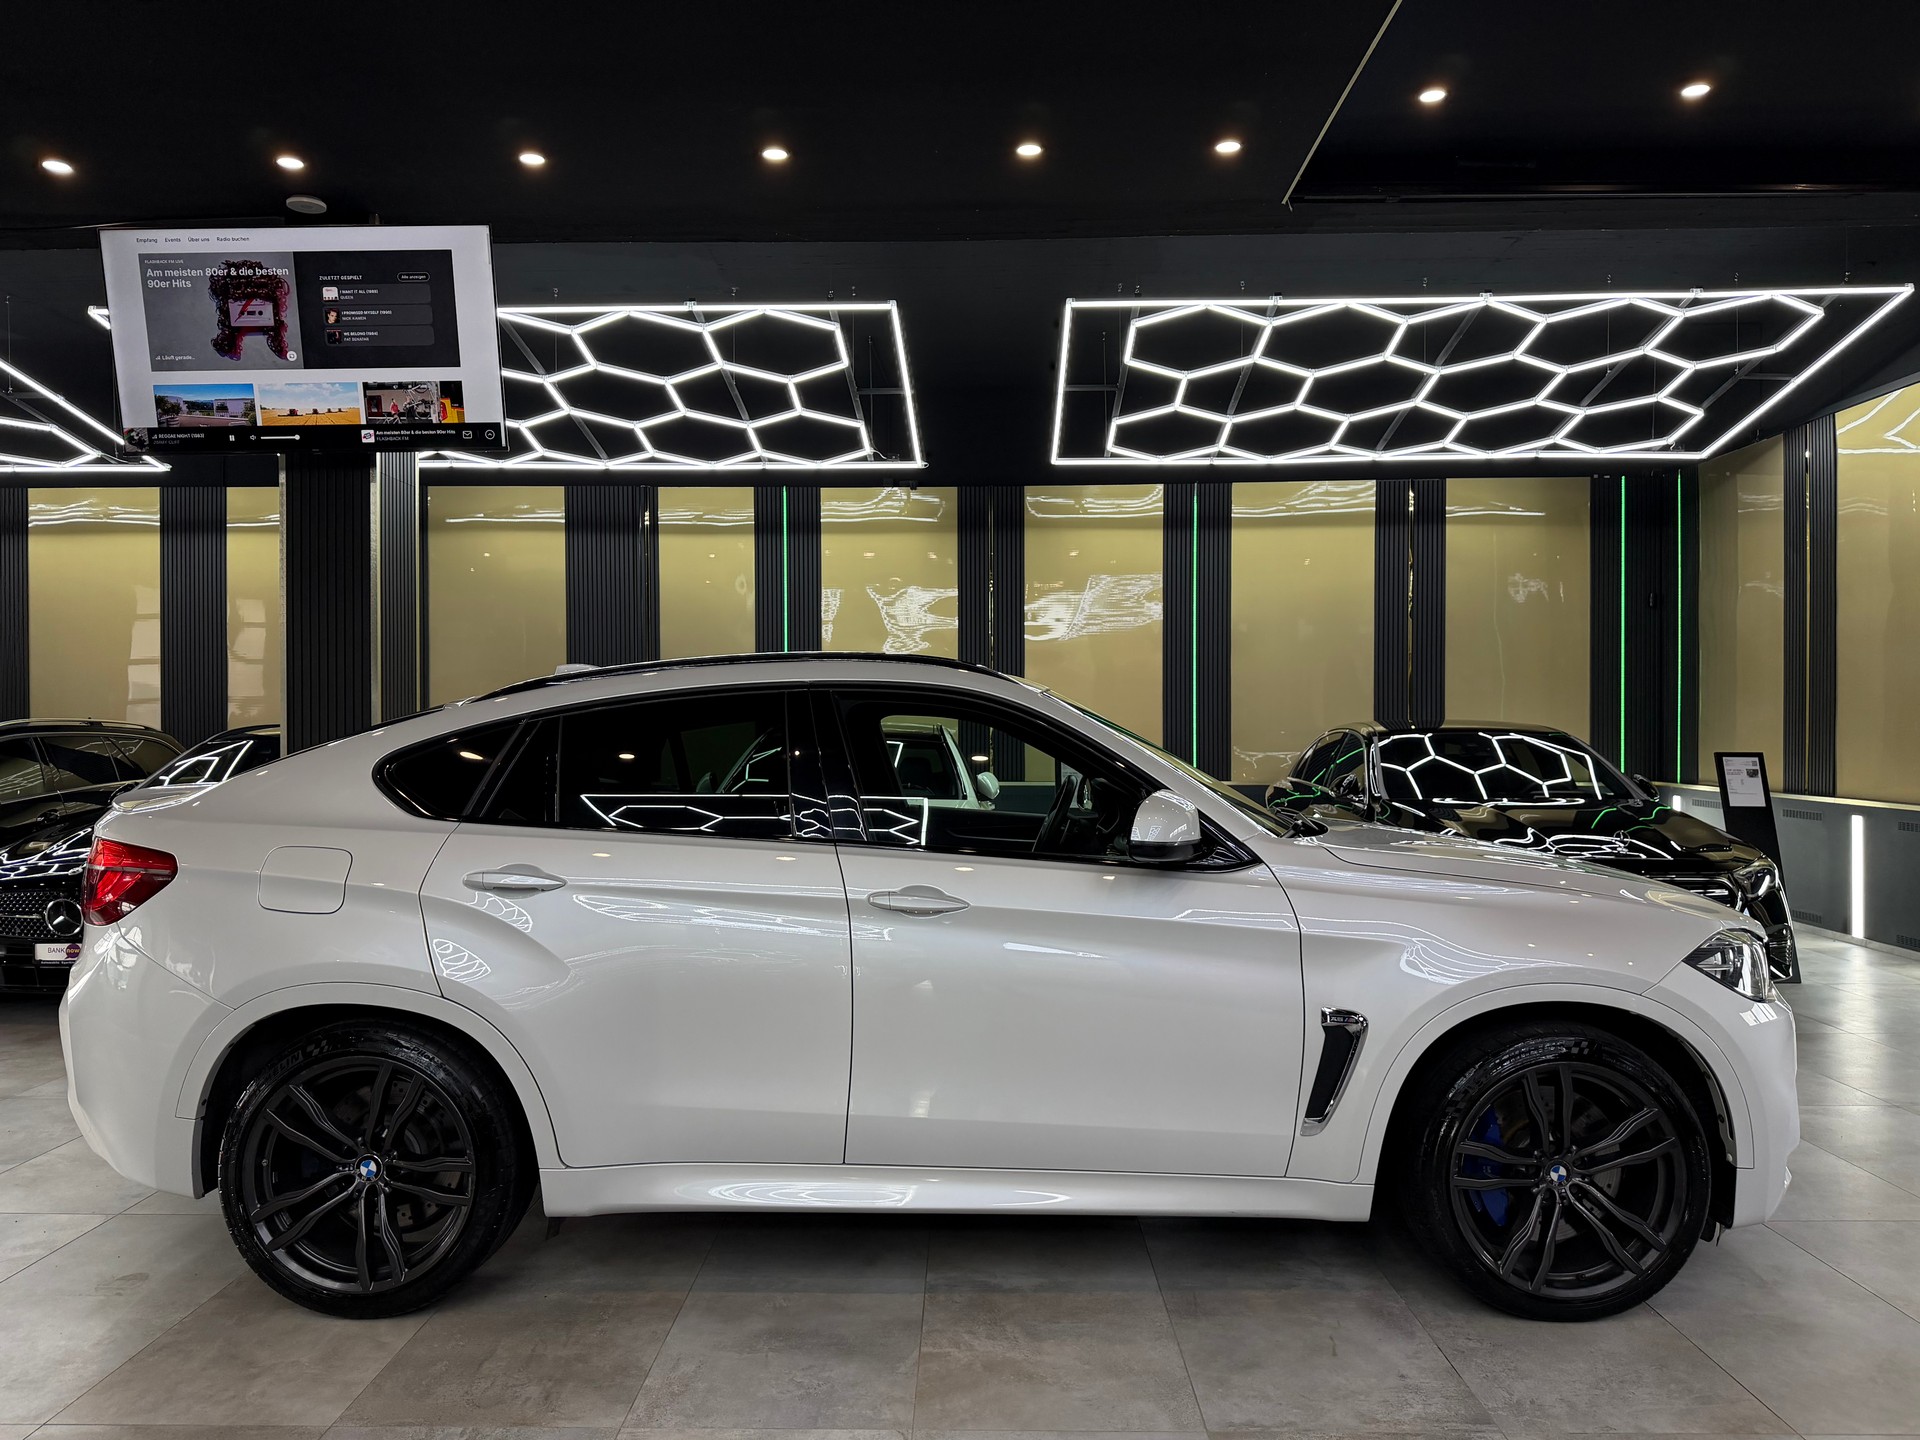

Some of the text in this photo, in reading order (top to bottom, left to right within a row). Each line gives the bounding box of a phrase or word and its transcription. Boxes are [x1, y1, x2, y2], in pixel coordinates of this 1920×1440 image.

[146, 266, 289, 277] Am meisten 80er & die besten
[148, 278, 192, 288] 90er Hits
[410, 1046, 436, 1062] Pilot
